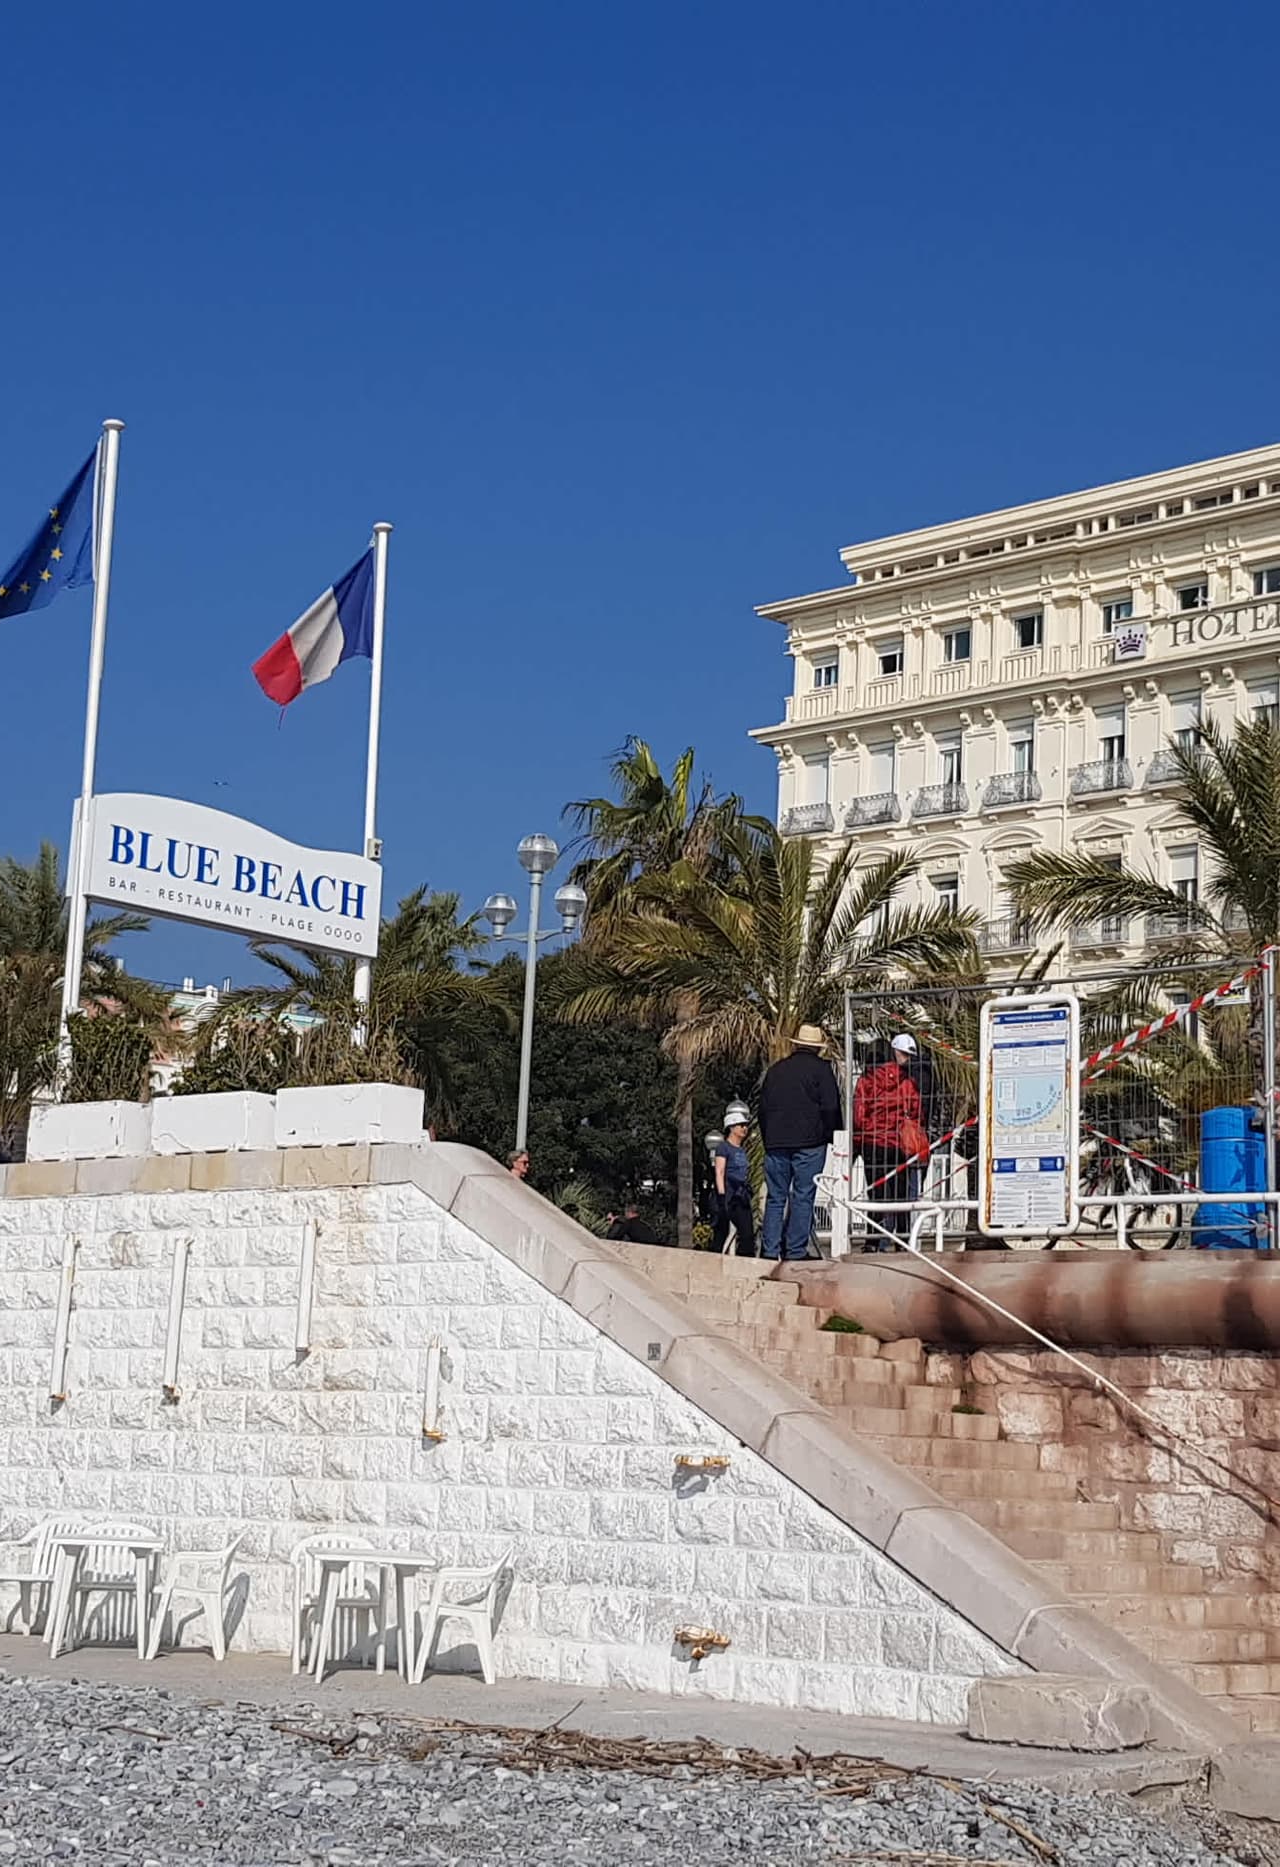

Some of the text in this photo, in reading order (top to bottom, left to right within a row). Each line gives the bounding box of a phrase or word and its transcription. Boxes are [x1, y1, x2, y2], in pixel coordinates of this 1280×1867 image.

[108, 823, 368, 920] BLUE BEACH
[108, 876, 137, 892] BAR
[158, 888, 252, 918] RESTAURANT
[271, 913, 313, 932] PLAGE
